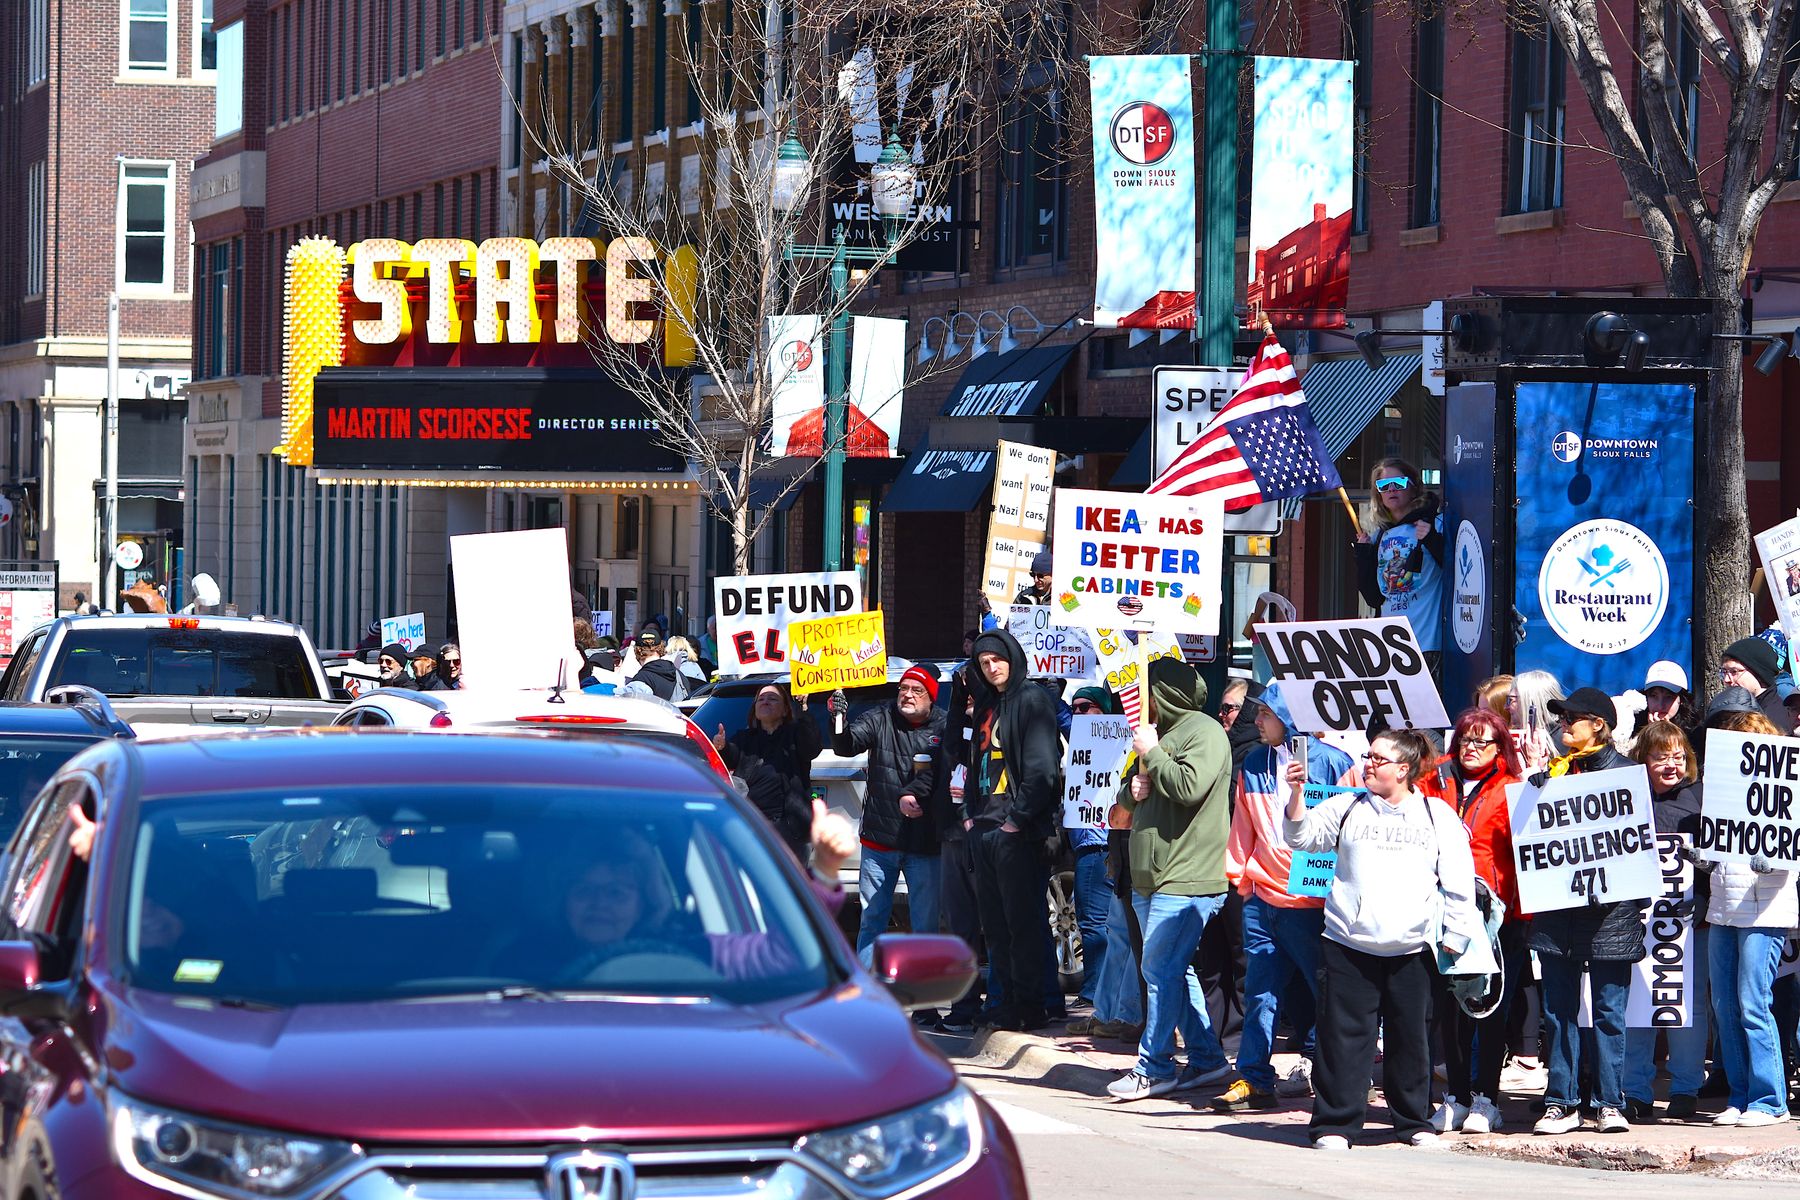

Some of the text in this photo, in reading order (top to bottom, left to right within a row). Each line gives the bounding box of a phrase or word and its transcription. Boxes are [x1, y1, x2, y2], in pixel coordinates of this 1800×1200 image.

[1119, 126, 1167, 143] DTSF
[1113, 169, 1176, 178] DOWN SIOUX
[1115, 178, 1175, 187] TOWN FALLS
[833, 203, 952, 223] WESERN
[350, 236, 656, 344] STATE
[1165, 388, 1239, 412] SPE
[327, 407, 661, 440] MARTIN SCORSESE DIRECTOR SERIES
[1554, 442, 1579, 452] DTSF
[1585, 439, 1658, 449] DOWNTOWN
[1009, 448, 1049, 466] We don't
[1001, 478, 1023, 490] want
[998, 504, 1046, 523] Nazi cars,
[1076, 506, 1204, 535] IKEA HAS
[1556, 525, 1652, 553] Downtown Sioux Falls
[1771, 528, 1795, 545] HANDS
[995, 541, 1014, 553] take
[1017, 548, 1023, 556] a
[1780, 541, 1793, 552] OFF
[1080, 542, 1200, 575] BETTER
[988, 579, 1005, 590] way
[1071, 576, 1183, 598] CABINETS
[722, 583, 854, 616] DEFUND
[1554, 589, 1653, 605] Restaurant
[1581, 607, 1627, 622] Week
[384, 618, 424, 643] I'm here
[802, 615, 880, 644] PROTECT
[1034, 632, 1066, 651] GOP
[1185, 634, 1204, 645] ZONE
[1579, 638, 1604, 649] April
[822, 643, 849, 657] the
[856, 639, 882, 662] KING!
[1258, 625, 1422, 680] HANDS
[1033, 653, 1085, 674] WTF?!!
[796, 664, 885, 688] CONSTITUTION
[1106, 662, 1140, 688] SAV
[1313, 680, 1413, 731] OFF!
[1072, 750, 1091, 766] ARE
[1740, 741, 1800, 781] SAVE
[1085, 770, 1111, 788] SICK
[1069, 785, 1081, 801] OF
[1747, 782, 1793, 820] OUR
[1078, 806, 1103, 823] THIS
[1537, 789, 1634, 830] DEVOUR
[1353, 825, 1430, 851] LAS VEGAS
[1518, 823, 1654, 872] FECULENCE
[1307, 859, 1334, 869] MORE
[1302, 877, 1328, 887] BANK
[1571, 867, 1608, 898] 47!
